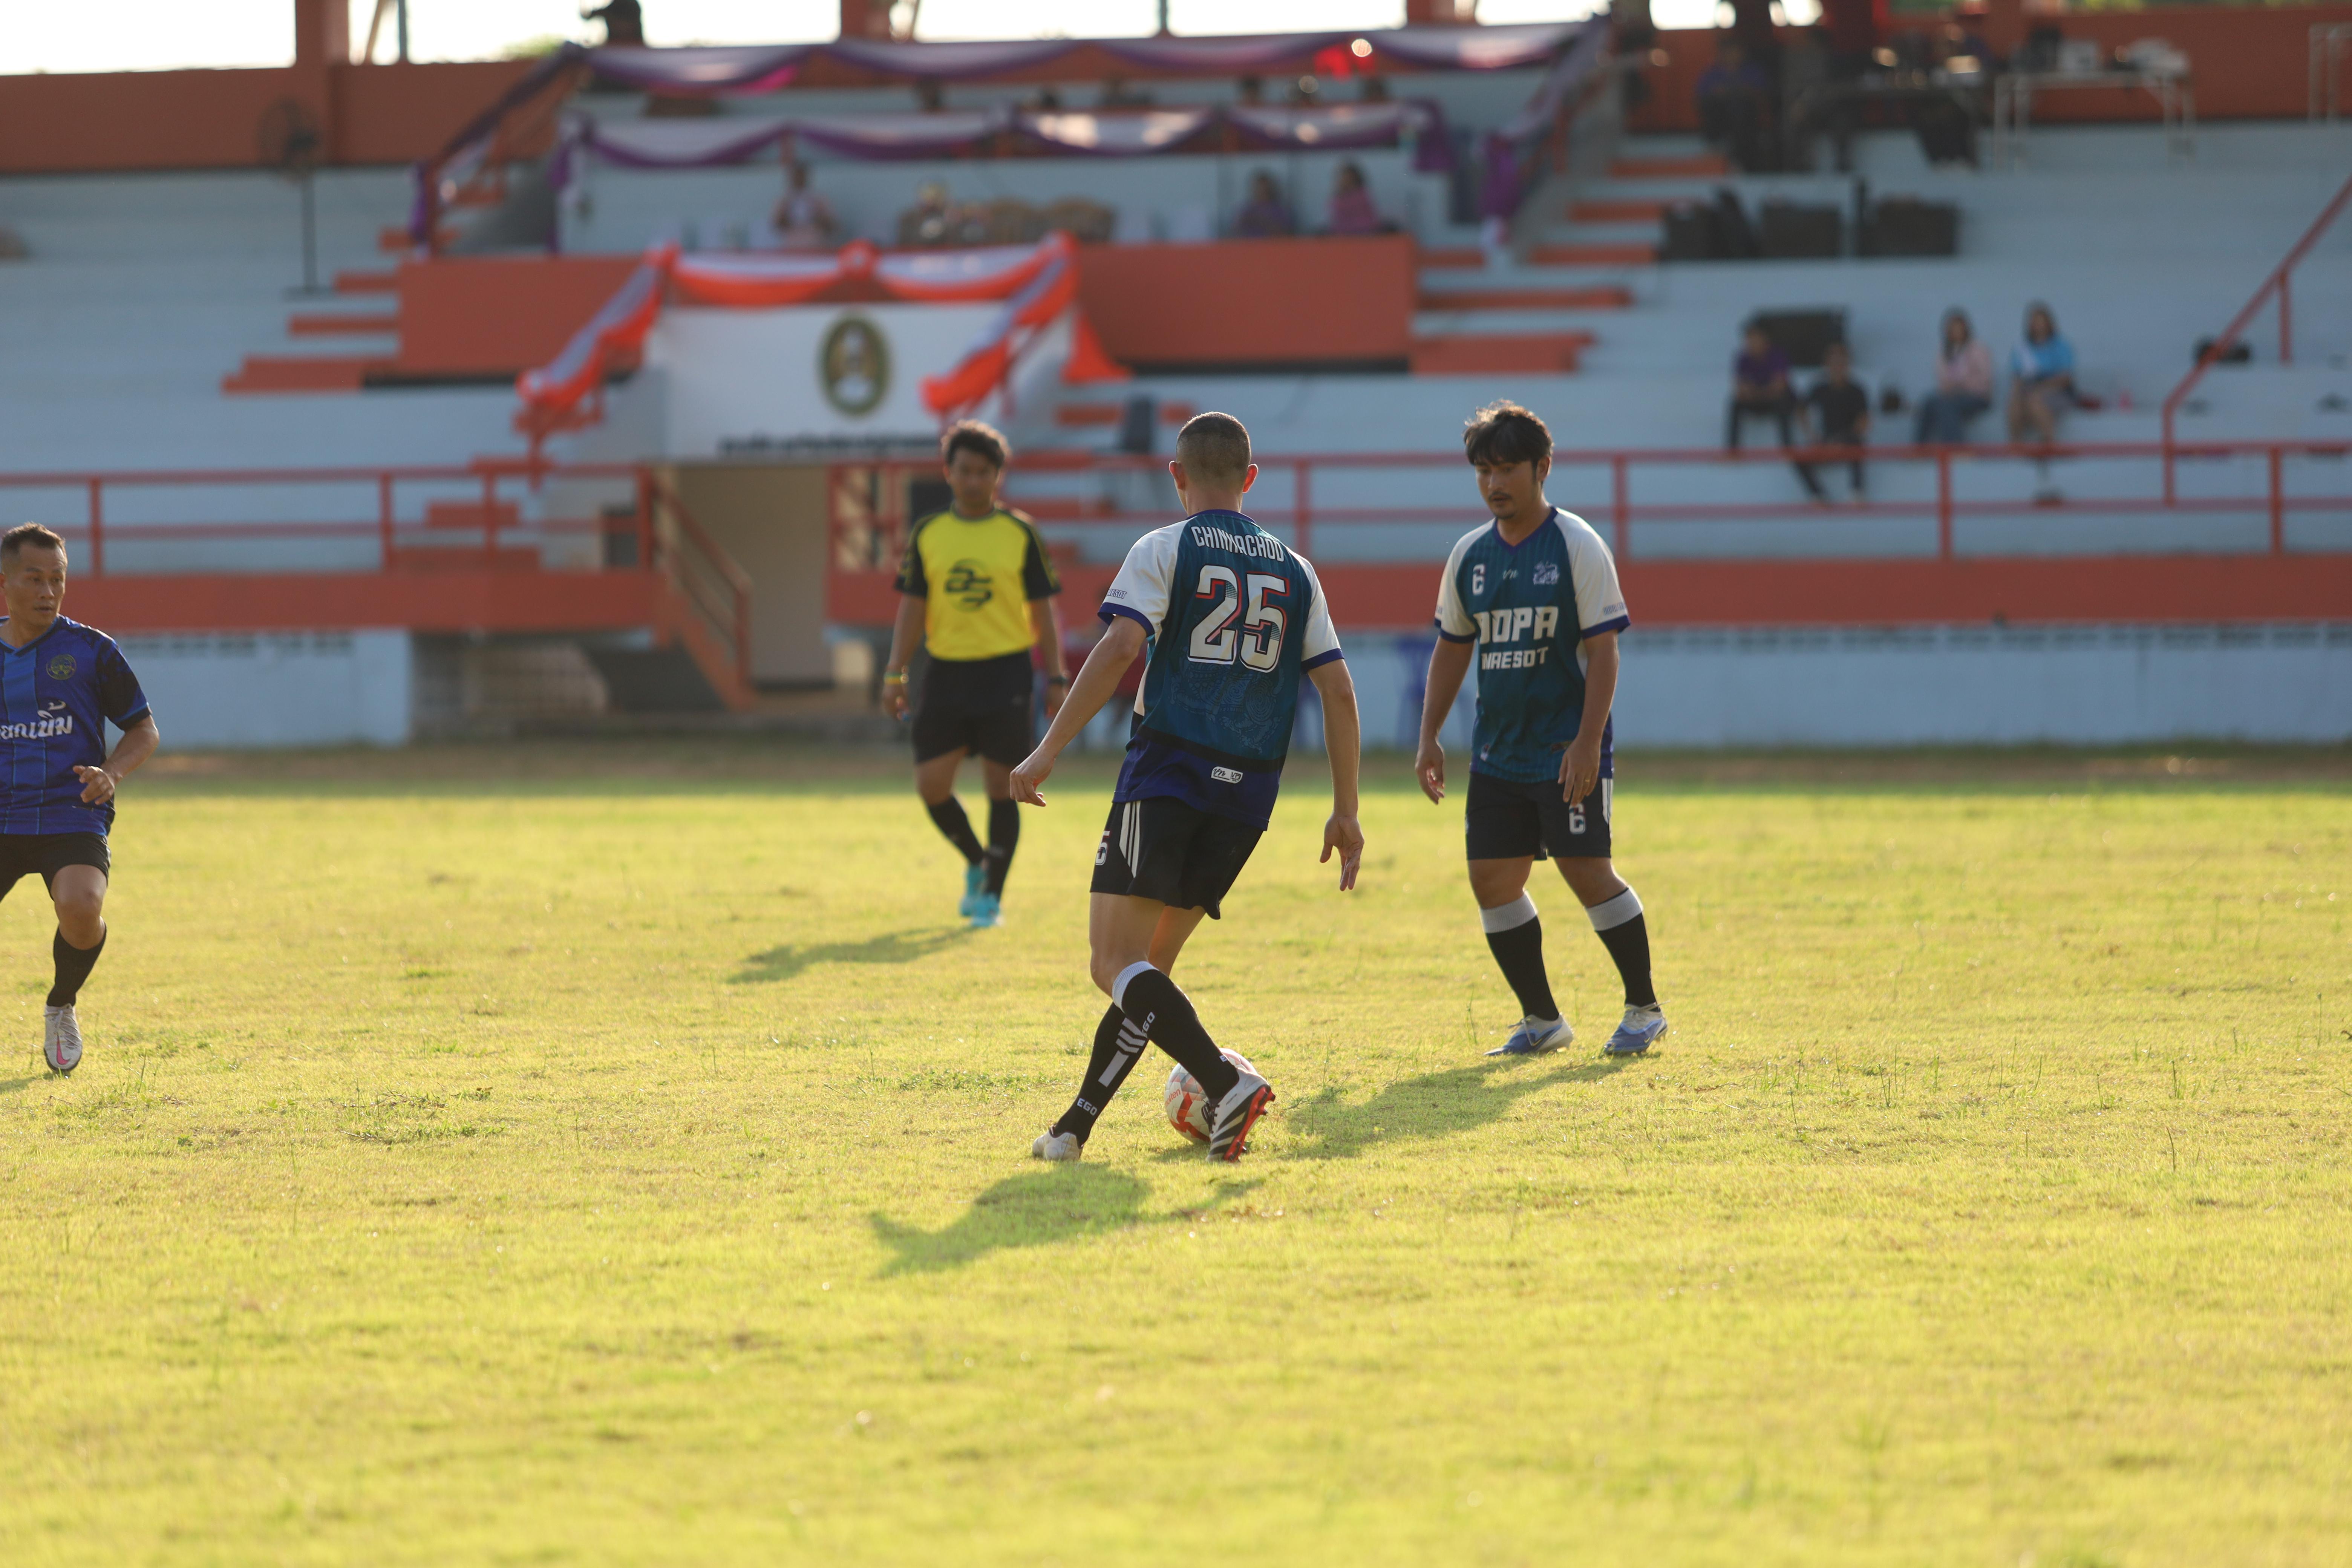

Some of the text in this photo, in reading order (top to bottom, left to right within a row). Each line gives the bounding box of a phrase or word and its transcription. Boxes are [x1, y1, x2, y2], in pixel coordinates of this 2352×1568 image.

[1472, 564, 1485, 595] 6
[1187, 564, 1291, 673] 25
[1568, 802, 1586, 835] 6
[1077, 1098, 1098, 1116] EGO
